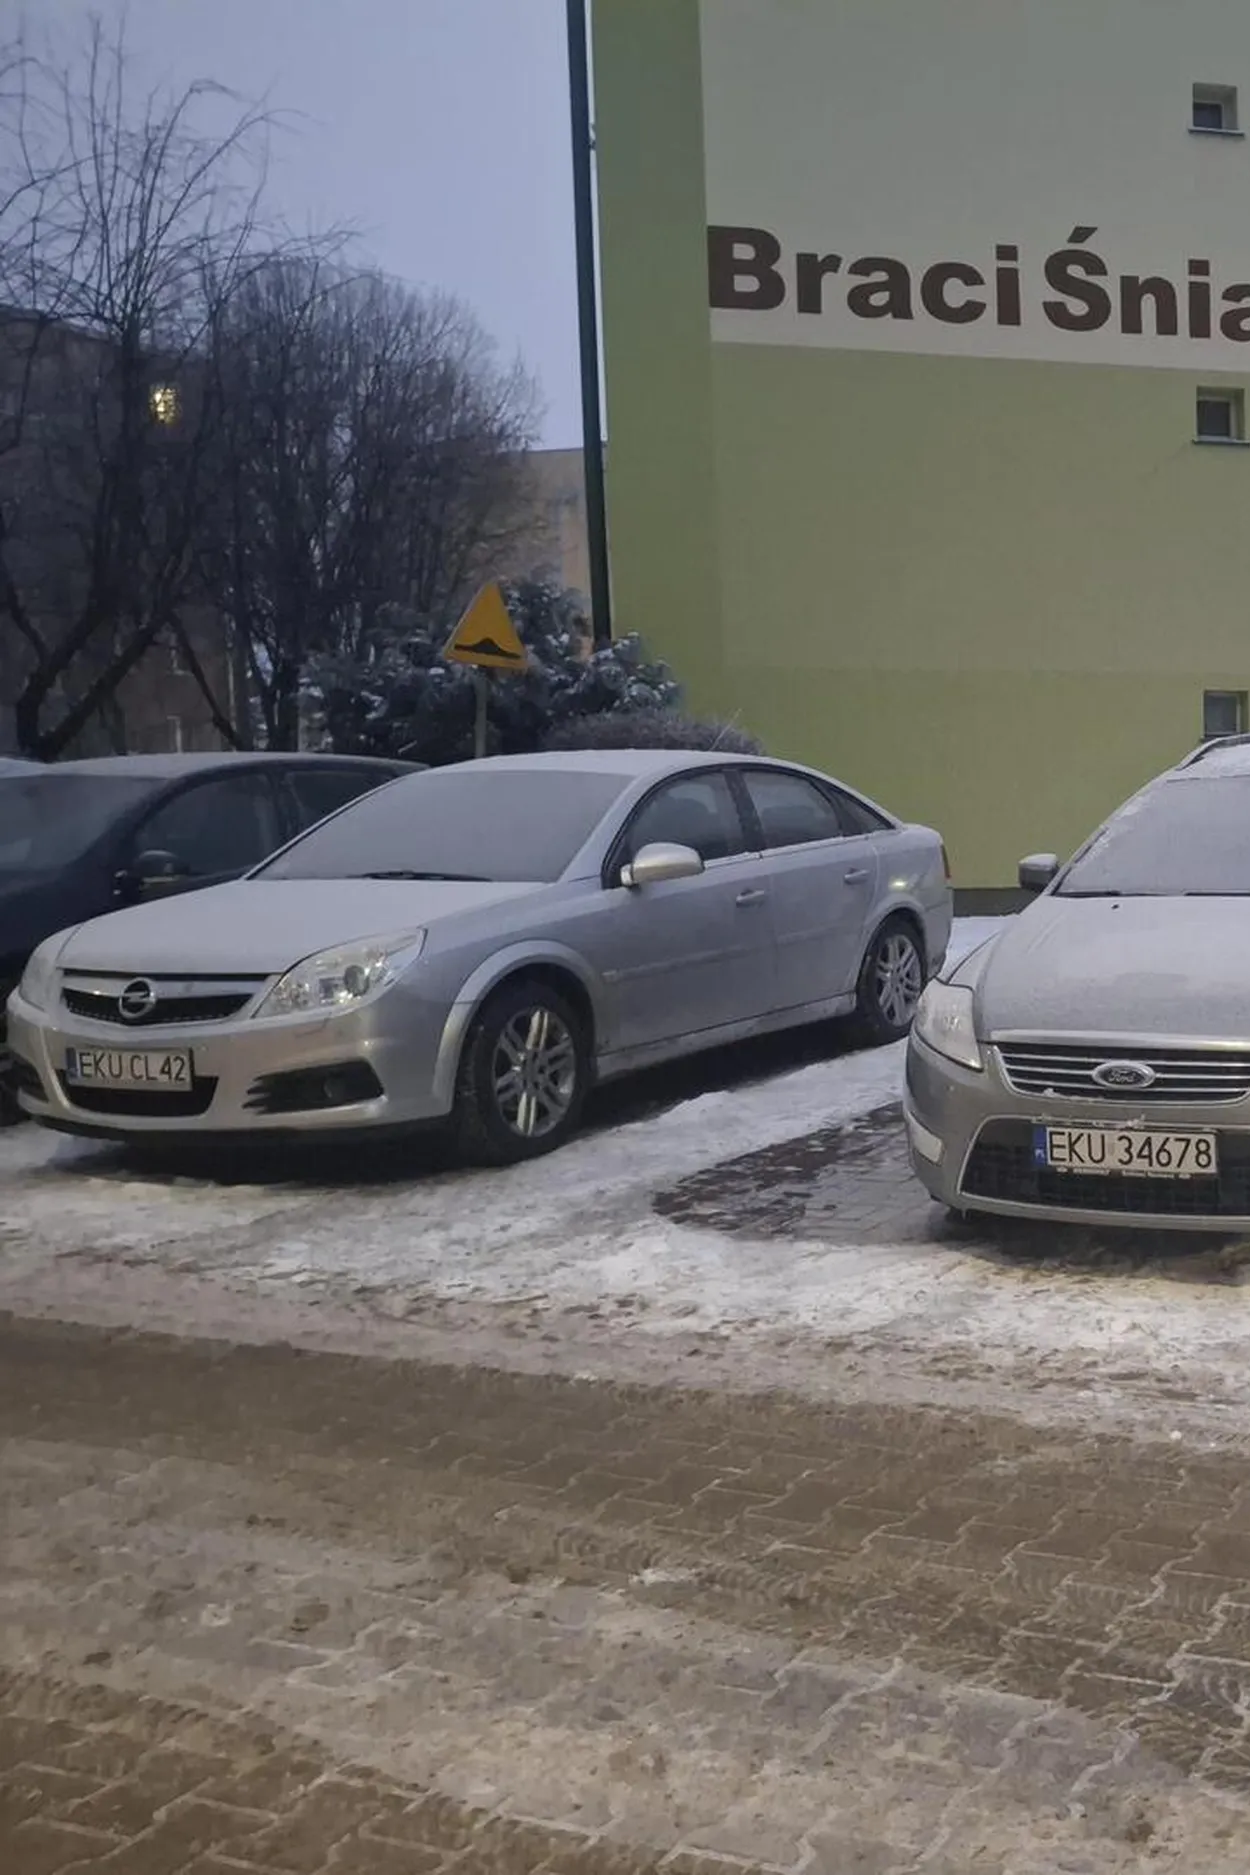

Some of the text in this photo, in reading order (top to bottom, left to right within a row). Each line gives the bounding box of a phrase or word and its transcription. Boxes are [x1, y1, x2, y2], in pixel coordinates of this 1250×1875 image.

[707, 225, 1021, 327] Braci
[79, 1051, 186, 1082] EKU CL42
[1049, 1131, 1213, 1169] EKU 34678
